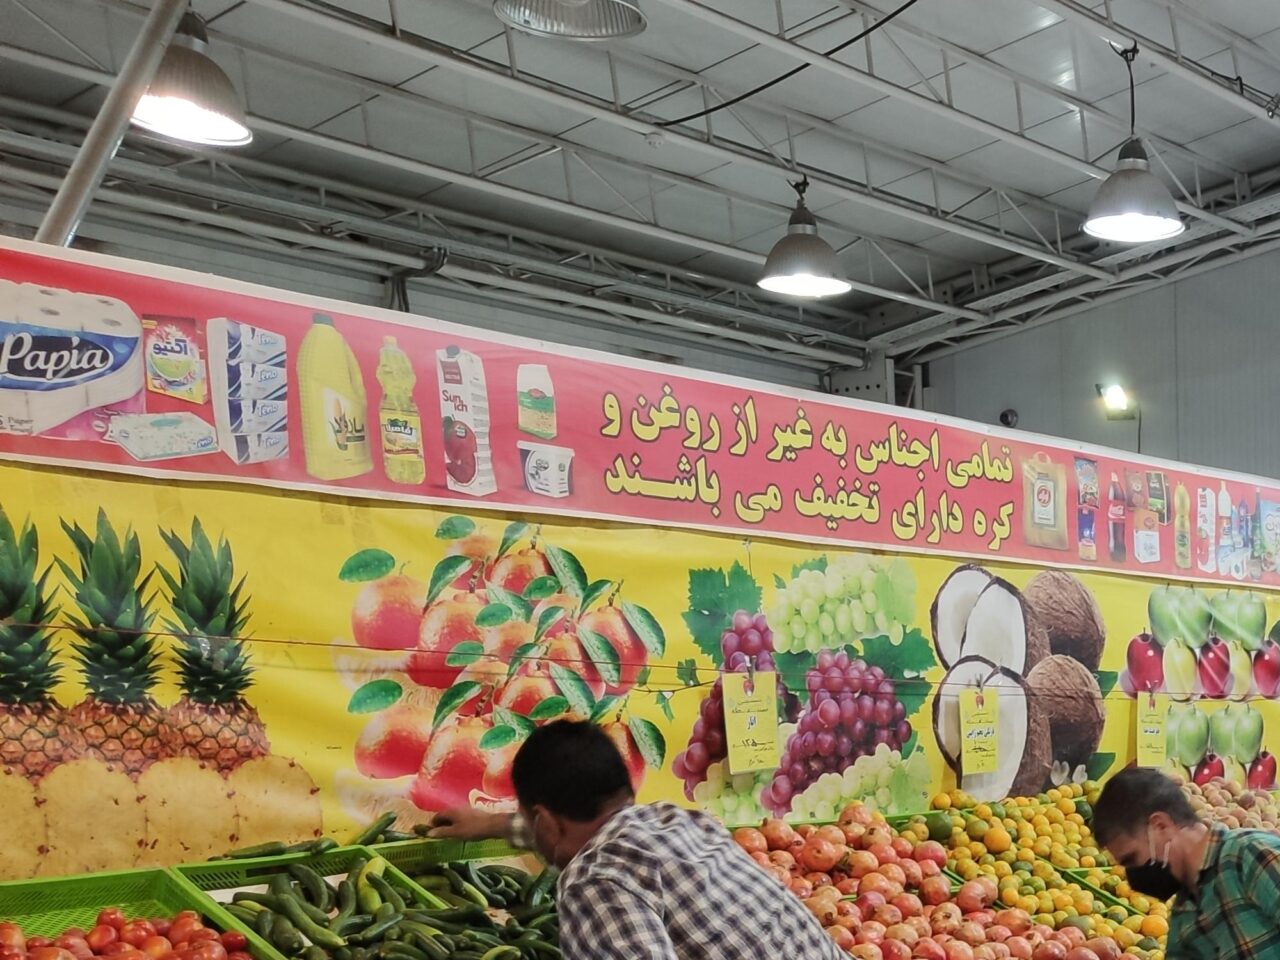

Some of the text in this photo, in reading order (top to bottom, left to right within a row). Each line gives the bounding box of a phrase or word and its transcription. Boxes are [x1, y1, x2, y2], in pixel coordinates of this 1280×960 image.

[2, 332, 106, 379] Papia
[600, 382, 1014, 488] تمامی اجناس به غیر از روغن و
[604, 452, 1014, 551] کره دارای تخفیف می باشند
